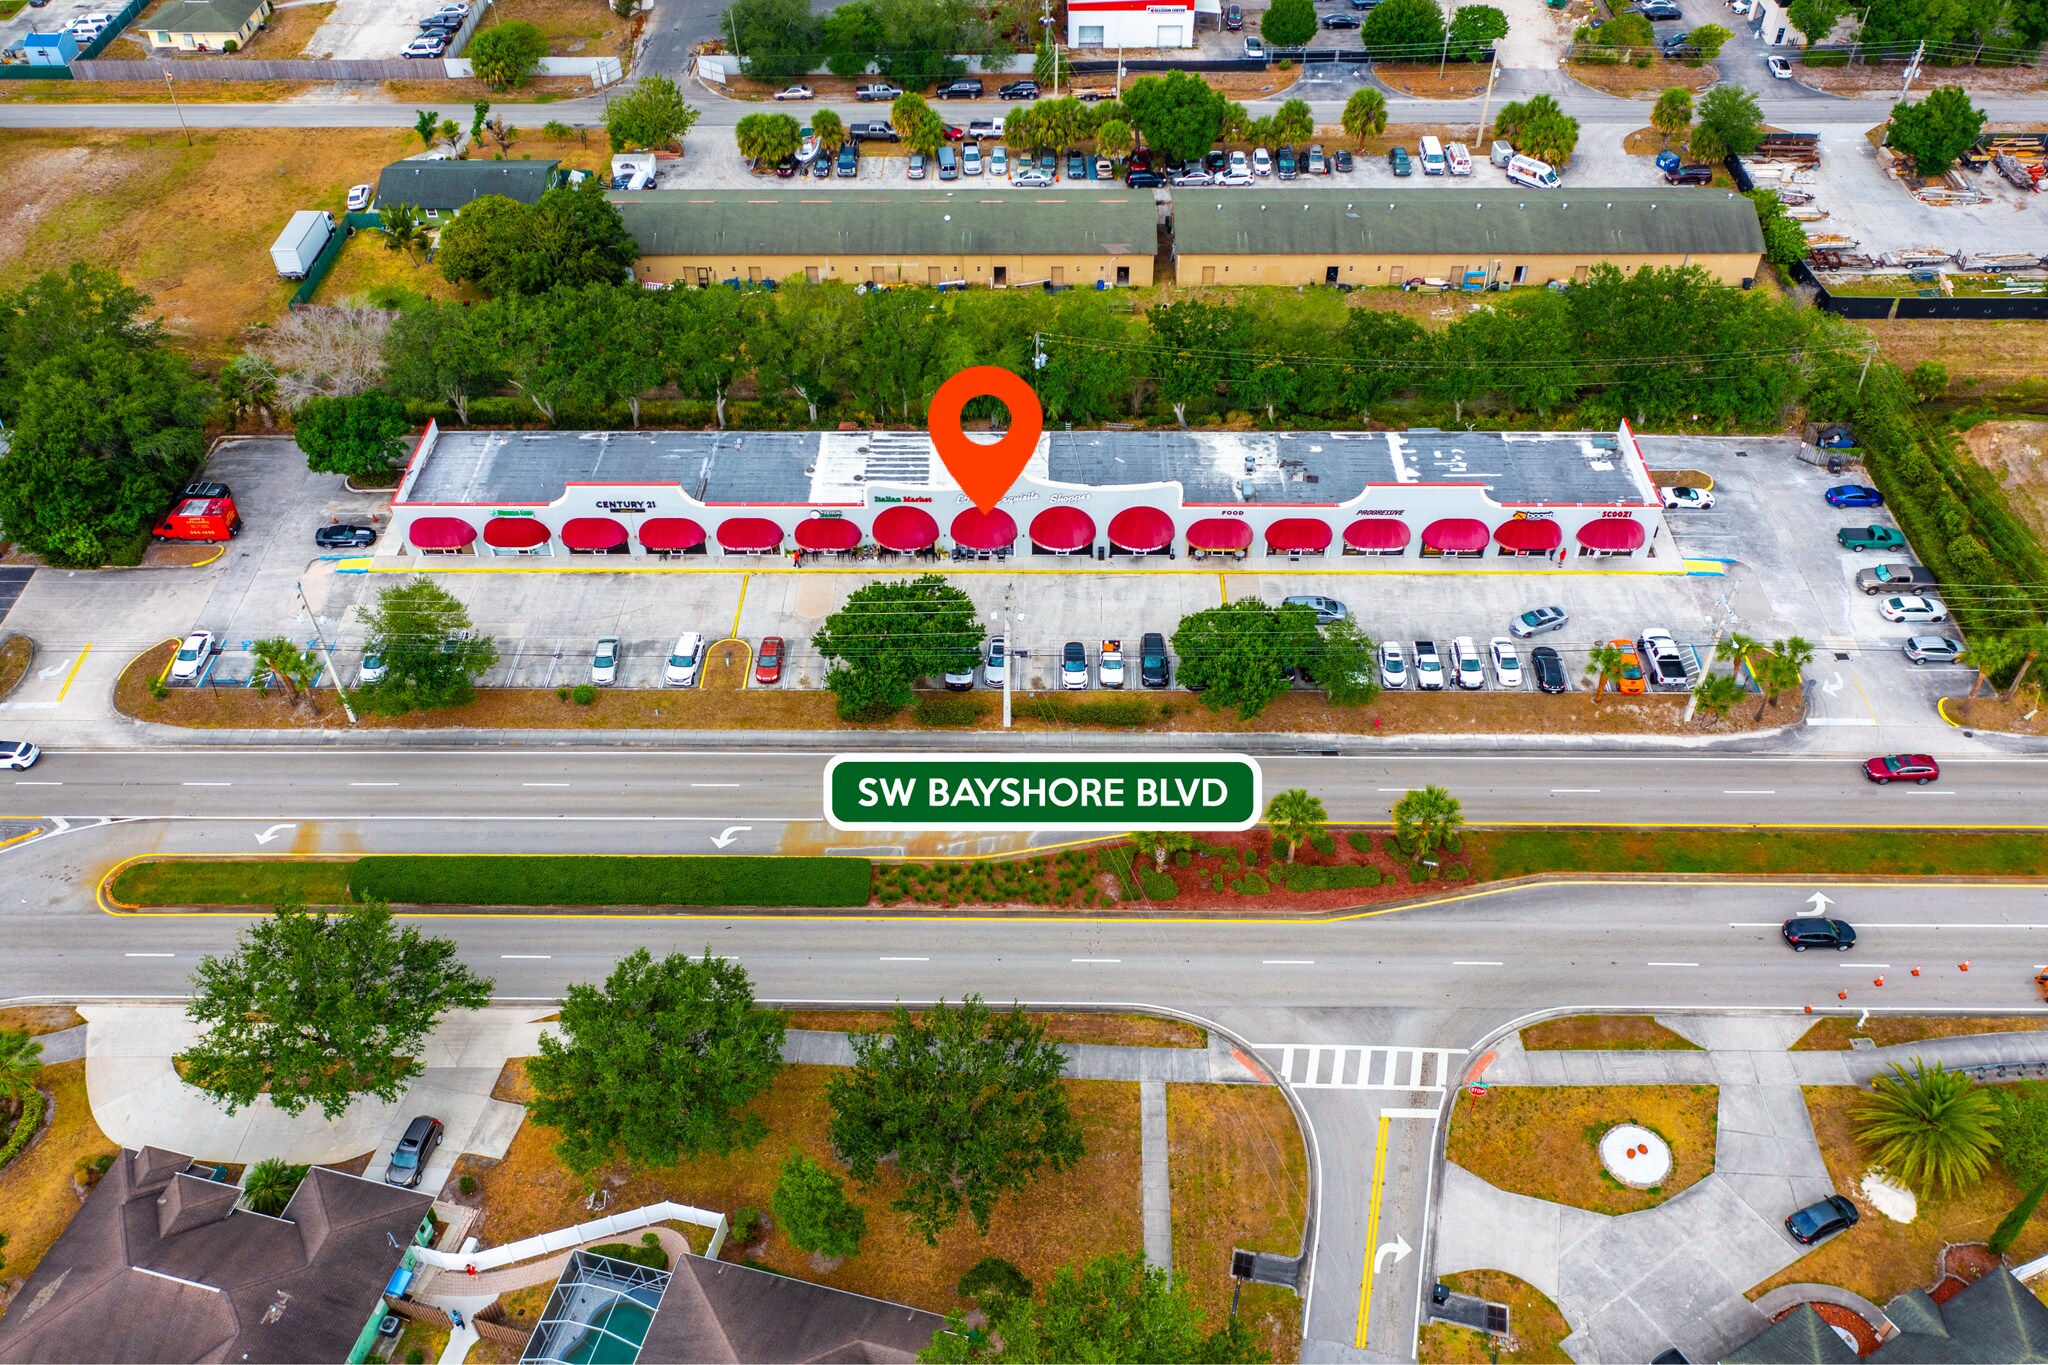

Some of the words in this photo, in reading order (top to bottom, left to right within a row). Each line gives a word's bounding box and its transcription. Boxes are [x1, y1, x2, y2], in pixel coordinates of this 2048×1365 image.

[1000, 491, 1039, 505] xquisite
[1050, 493, 1092, 504] Shoppes
[1526, 511, 1553, 519] boost
